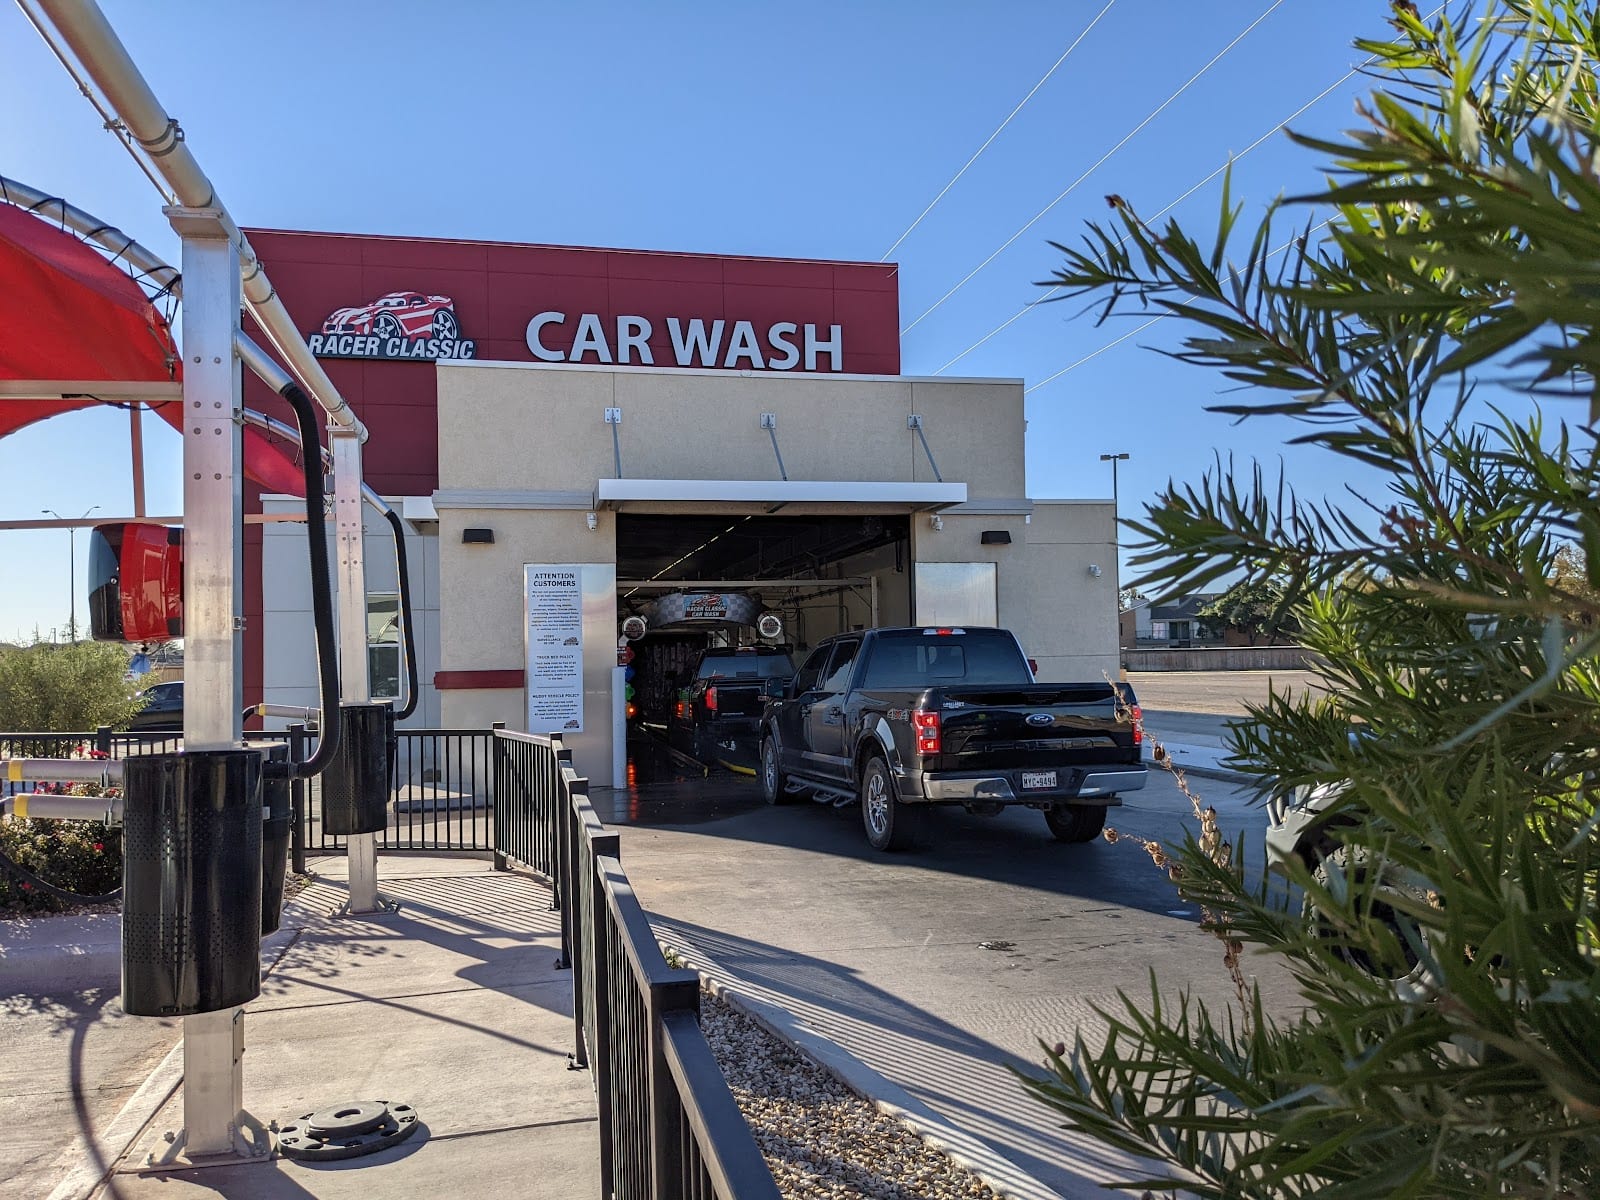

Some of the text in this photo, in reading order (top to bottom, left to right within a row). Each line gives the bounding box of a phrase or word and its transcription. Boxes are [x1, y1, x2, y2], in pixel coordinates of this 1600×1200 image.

[308, 334, 474, 360] RACER CLASSIC
[525, 311, 842, 371] CAR WASH
